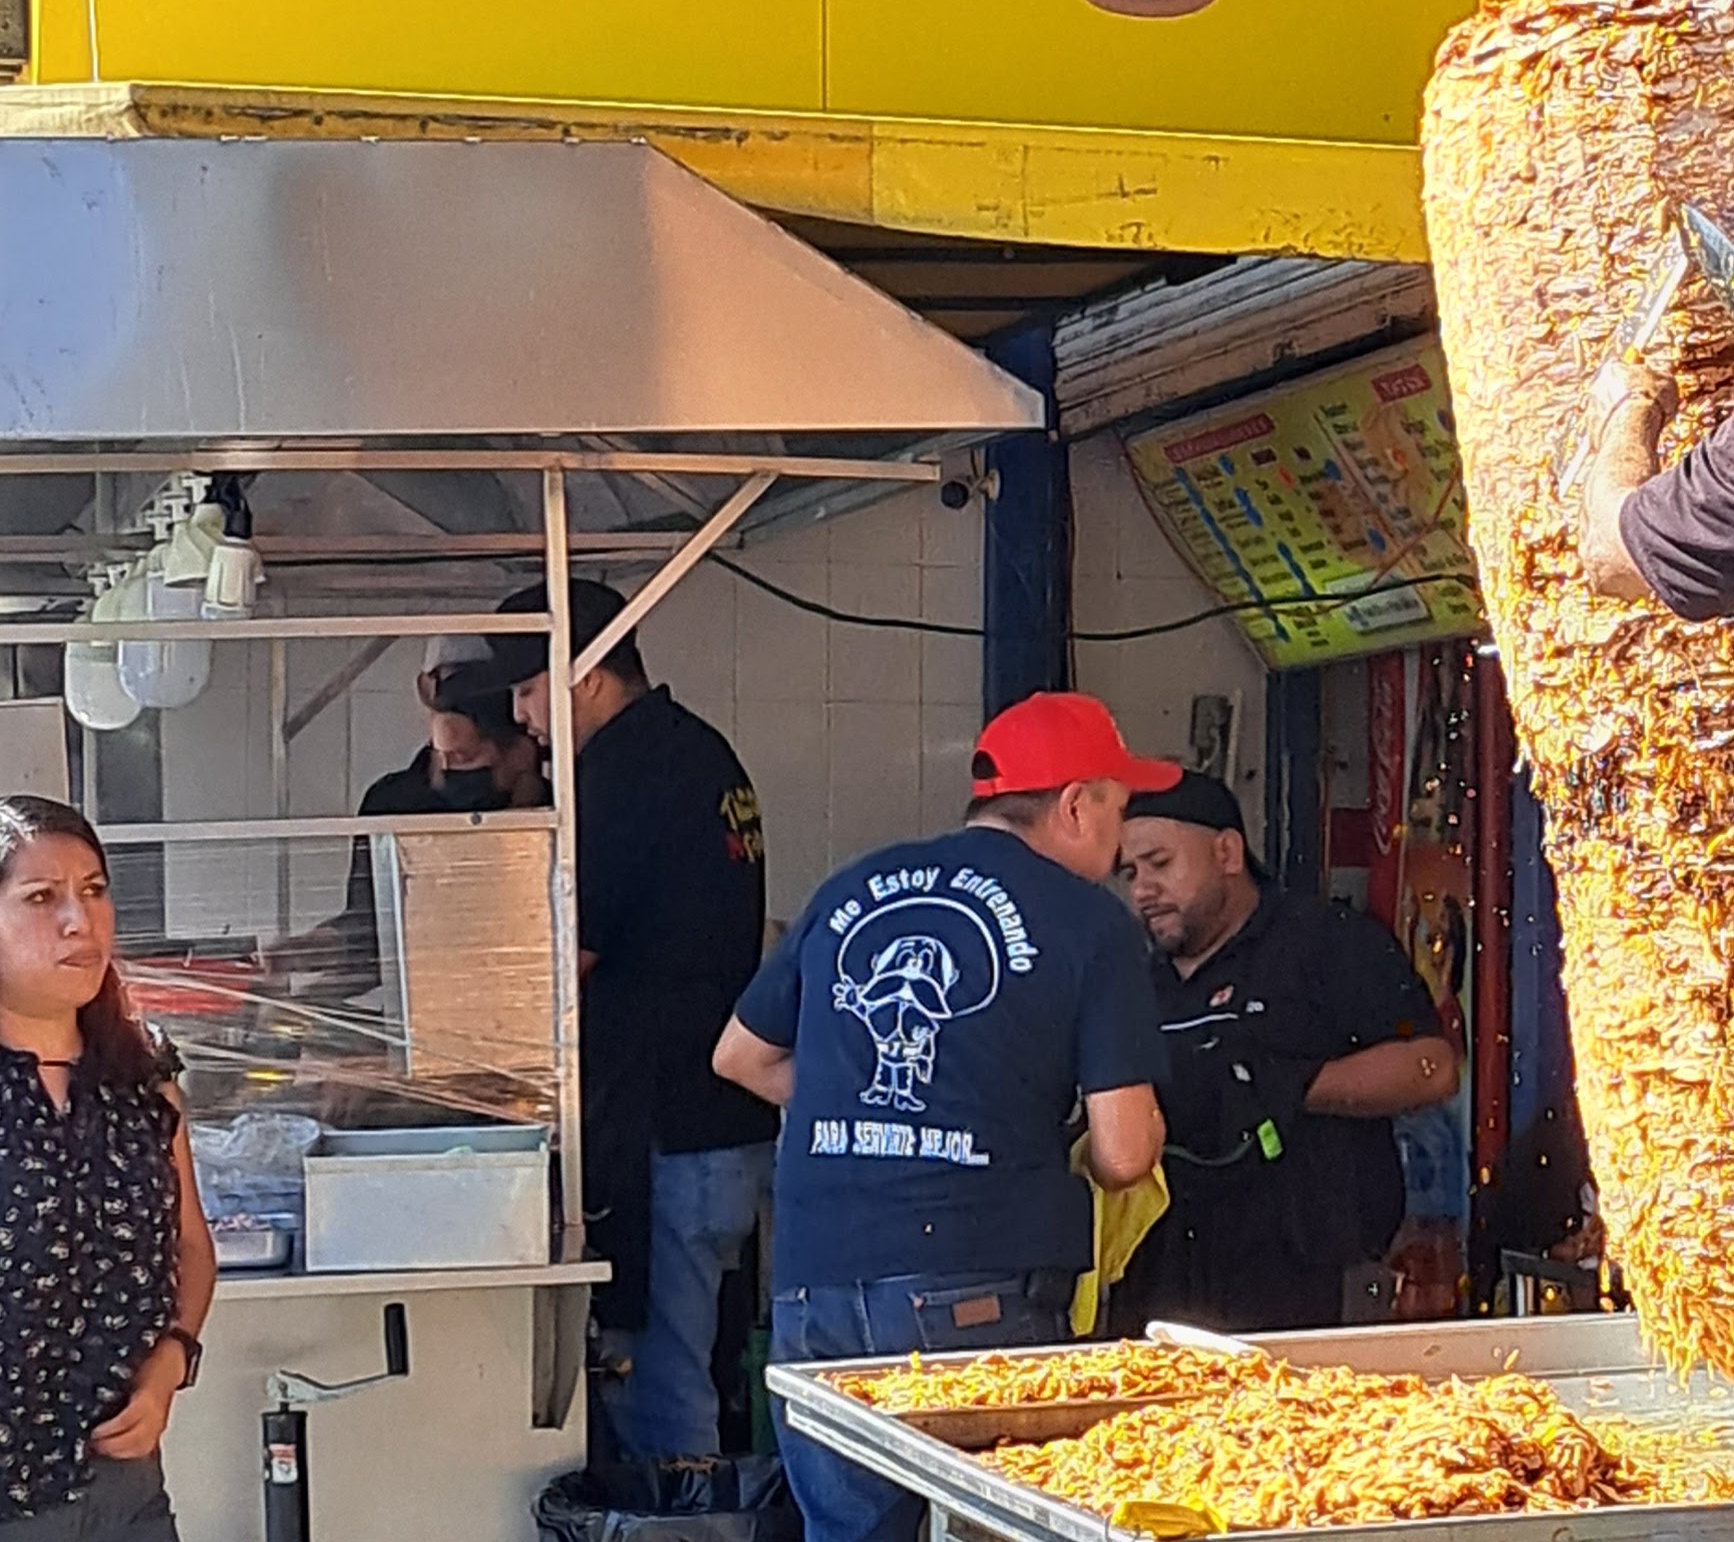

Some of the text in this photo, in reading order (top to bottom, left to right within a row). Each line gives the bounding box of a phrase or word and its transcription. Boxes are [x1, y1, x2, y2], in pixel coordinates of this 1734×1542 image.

[828, 865, 1040, 974] Me Estoy Entrenando
[808, 1119, 849, 1156] PARA
[851, 1120, 916, 1158] SERVIRTE
